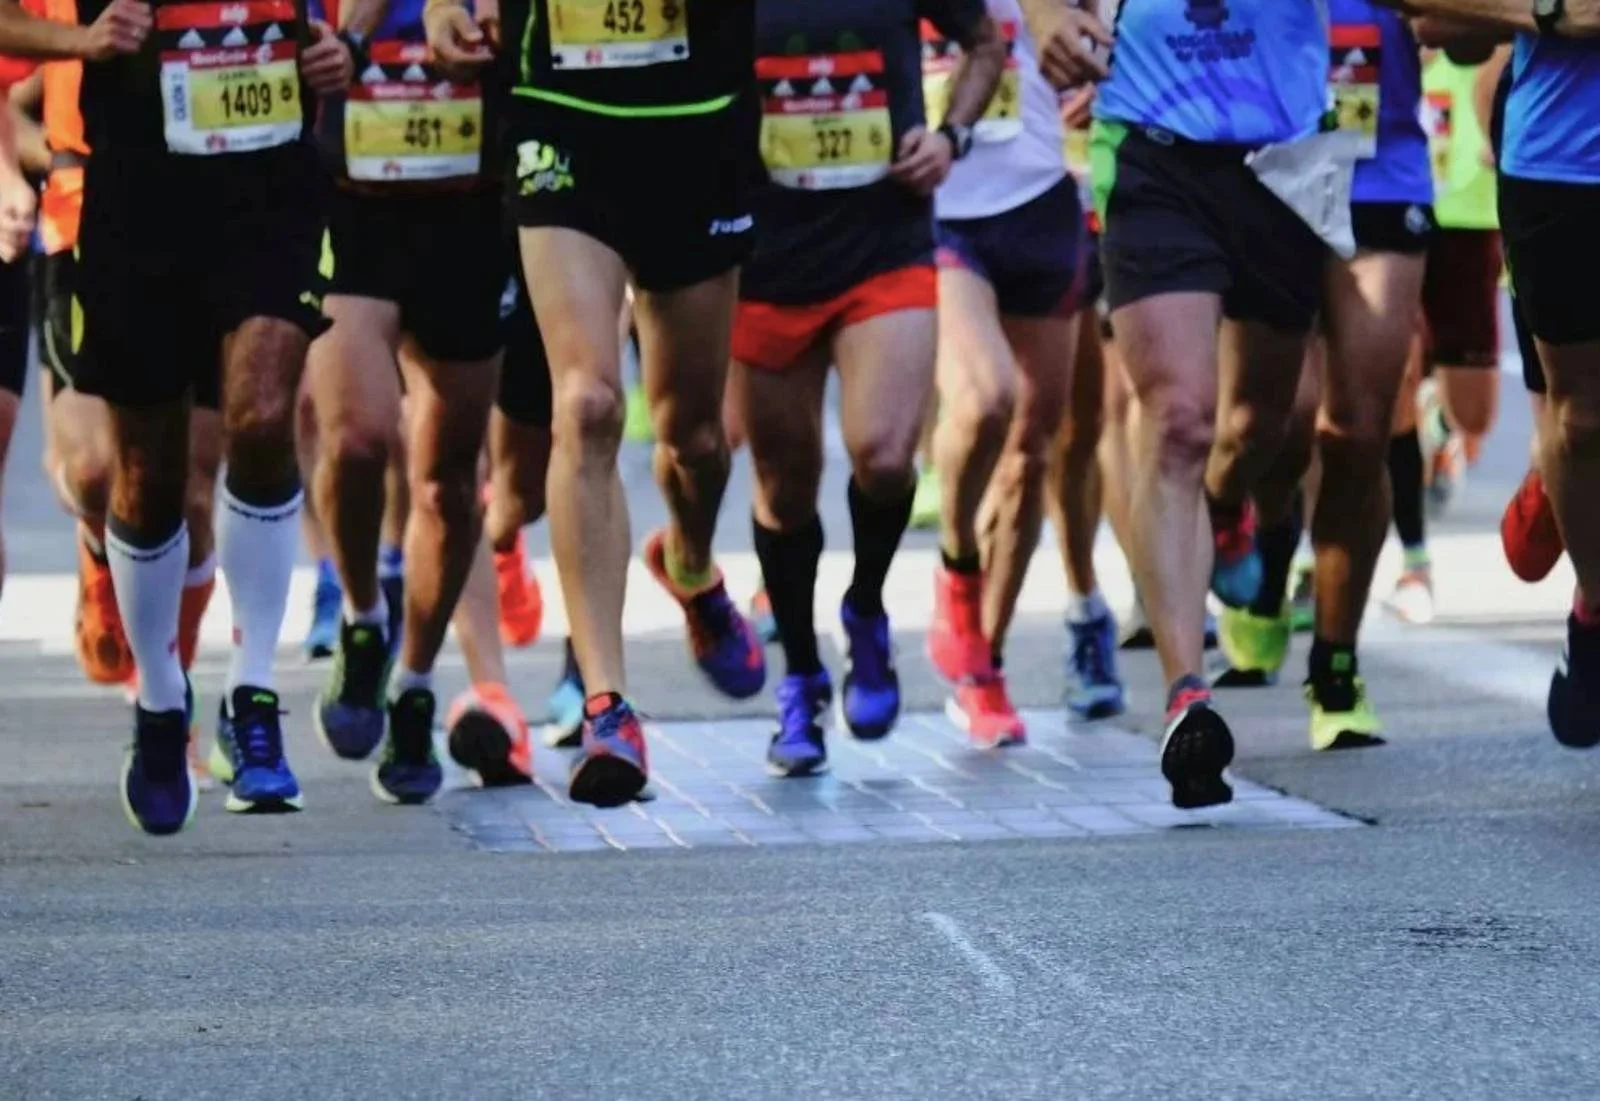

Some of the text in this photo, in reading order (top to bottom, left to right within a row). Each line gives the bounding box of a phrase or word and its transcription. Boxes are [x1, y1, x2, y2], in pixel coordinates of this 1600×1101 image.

[603, 0, 645, 34] 452
[221, 82, 272, 119] 1409
[404, 117, 441, 148] 461
[816, 128, 852, 159] 327
